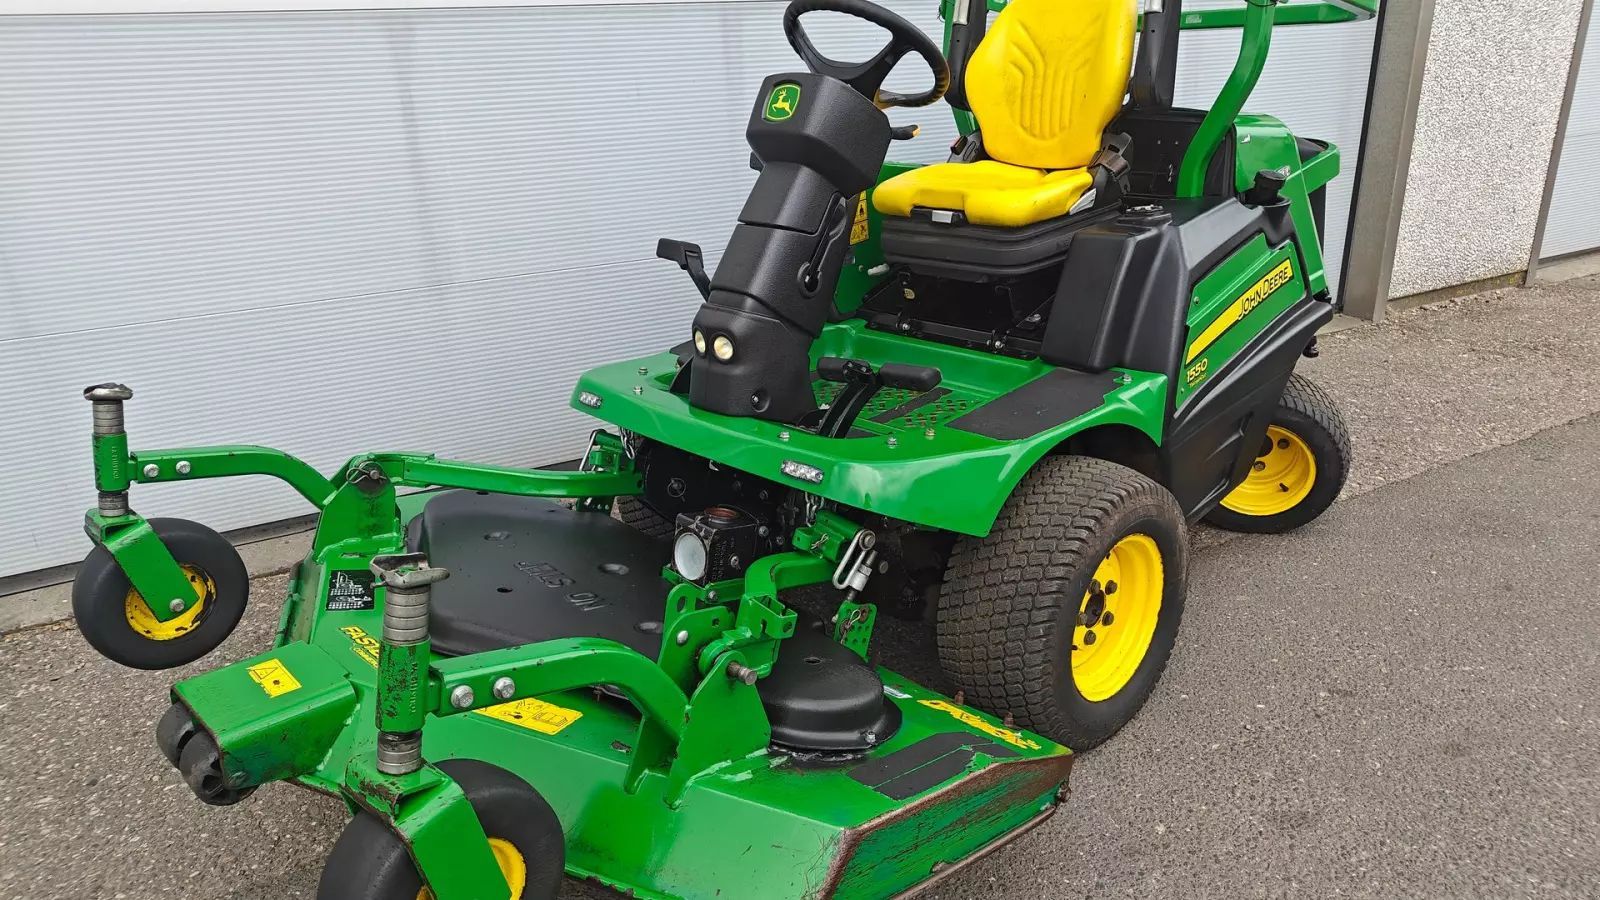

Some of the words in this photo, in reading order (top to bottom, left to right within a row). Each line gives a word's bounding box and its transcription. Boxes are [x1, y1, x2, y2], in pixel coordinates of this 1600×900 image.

[1238, 288, 1263, 317] JOHN
[1263, 267, 1289, 298] DEERE
[1187, 359, 1208, 382] 1550
